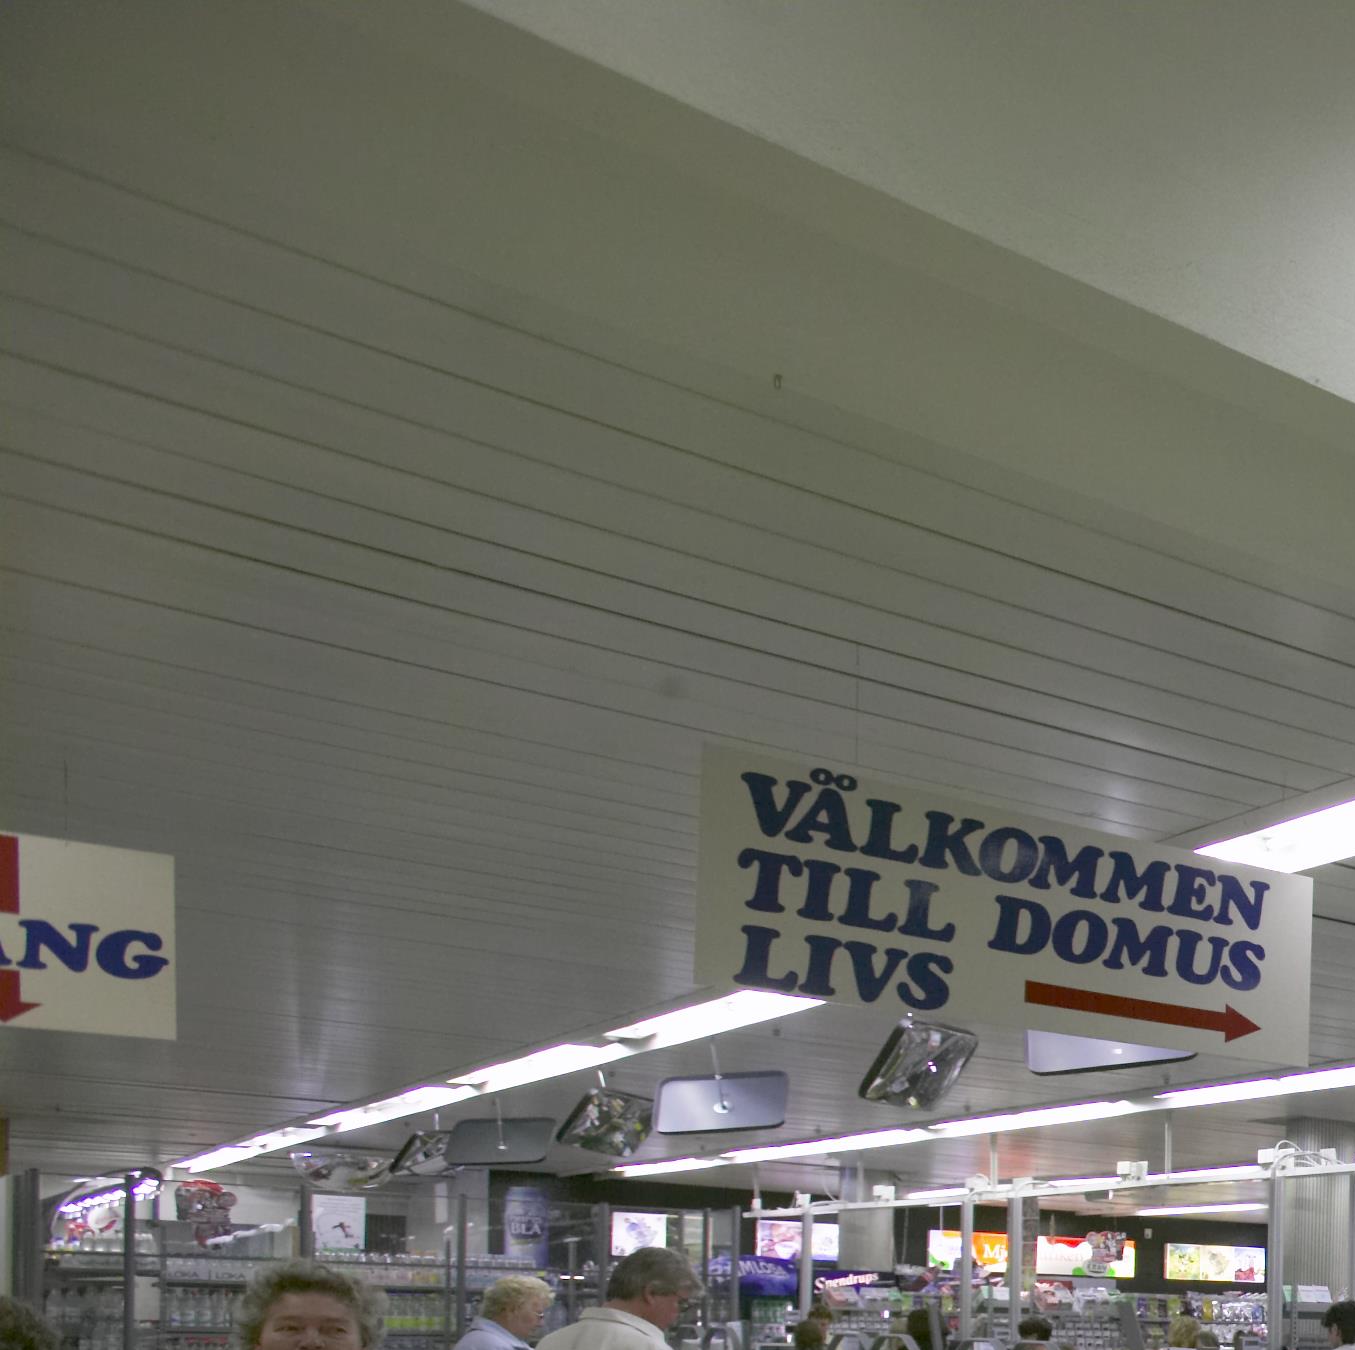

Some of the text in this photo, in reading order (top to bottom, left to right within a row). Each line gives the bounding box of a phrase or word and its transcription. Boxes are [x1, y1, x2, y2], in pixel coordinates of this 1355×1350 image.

[741, 767, 1270, 931] VÄLKOMMEN
[0, 919, 169, 980] NG
[734, 924, 954, 1011] LIVS
[737, 847, 1266, 992] TILL DOMUS
